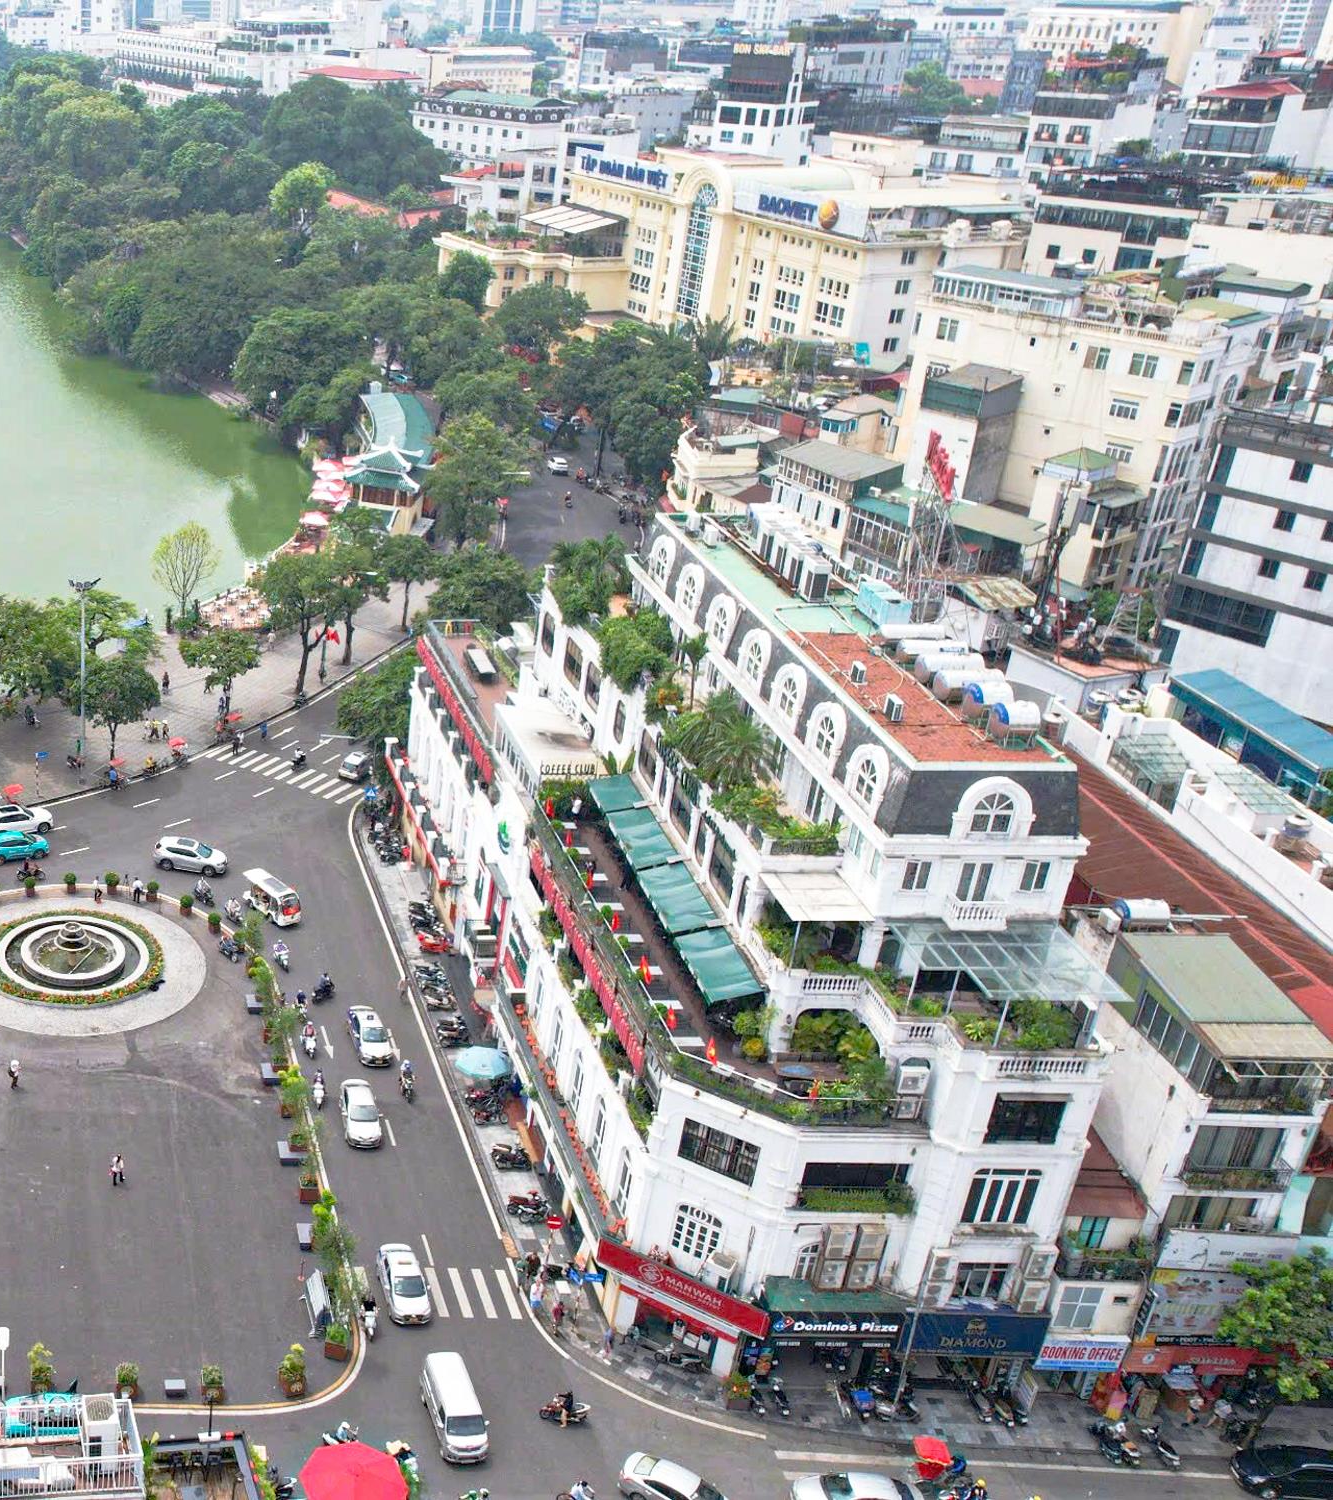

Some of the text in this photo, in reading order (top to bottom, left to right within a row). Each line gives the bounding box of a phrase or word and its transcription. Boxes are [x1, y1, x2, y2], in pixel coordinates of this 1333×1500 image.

[646, 169, 668, 190] VIỆT
[540, 763, 595, 775] COFFEE CLUB
[665, 1275, 723, 1307] MANWAH
[793, 1320, 898, 1333] Domino's Pizza
[939, 1336, 1007, 1349] DIAMOND
[1041, 1345, 1087, 1360] BOOKING
[1087, 1347, 1124, 1361] OFFICE
